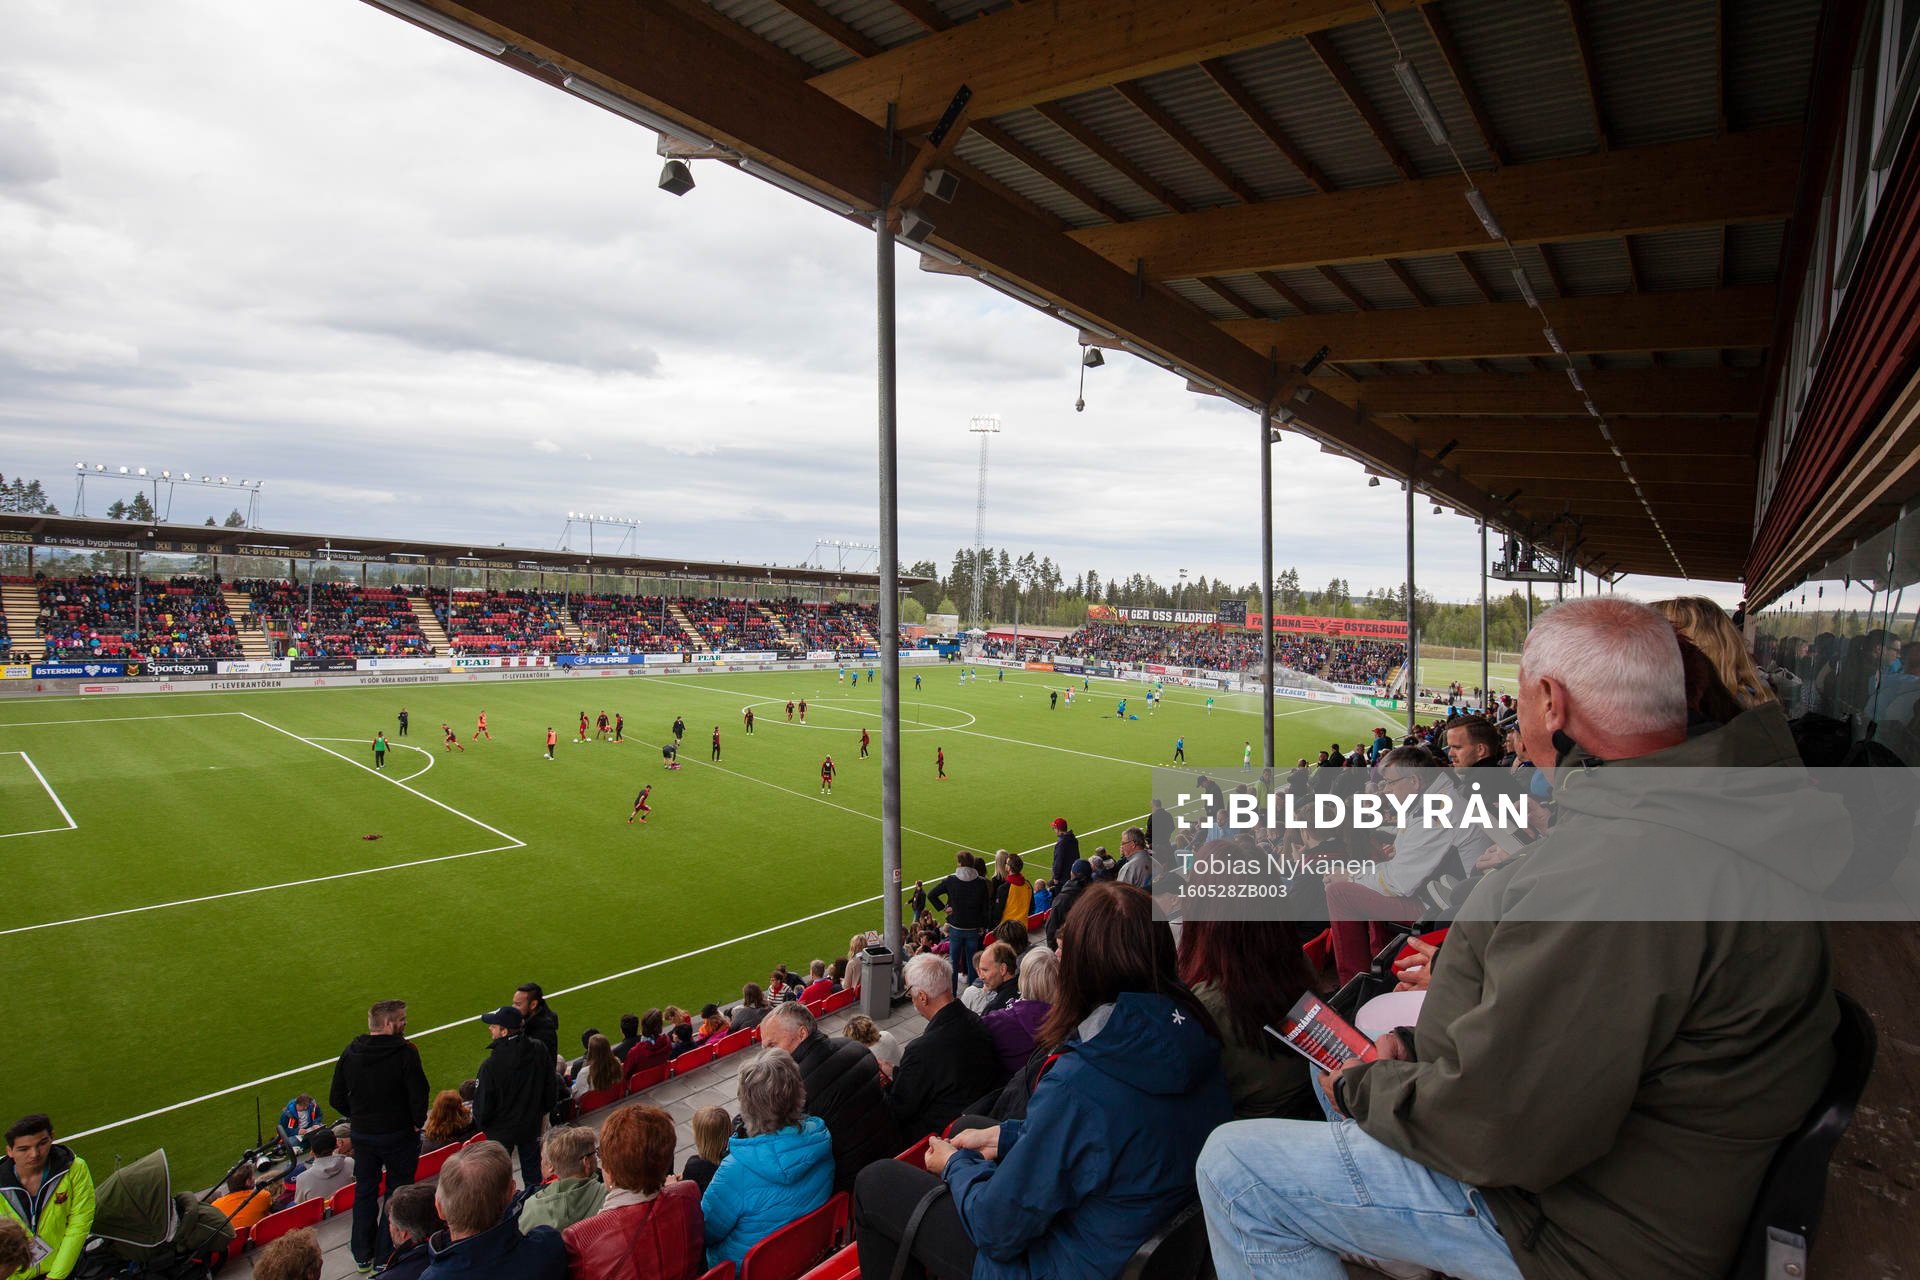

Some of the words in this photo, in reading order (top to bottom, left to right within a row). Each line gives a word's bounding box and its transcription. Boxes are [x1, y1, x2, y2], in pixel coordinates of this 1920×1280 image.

[0, 533, 33, 543] ESKS
[44, 536, 57, 544] En
[60, 537, 85, 547] riktig
[87, 538, 138, 549] bygghandel
[238, 546, 276, 556] XL-BYGG
[279, 549, 311, 558] FRESKS
[1131, 609, 1150, 620] GER
[1152, 610, 1172, 621] OSS
[1174, 612, 1217, 624] ALDRIG!
[456, 659, 491, 667] PEAB
[588, 656, 630, 664] POLARIS
[36, 667, 83, 675] ÖSTERSUND
[147, 663, 209, 675] Sportsgym
[211, 680, 282, 689] IT-LEVERANTÖREN
